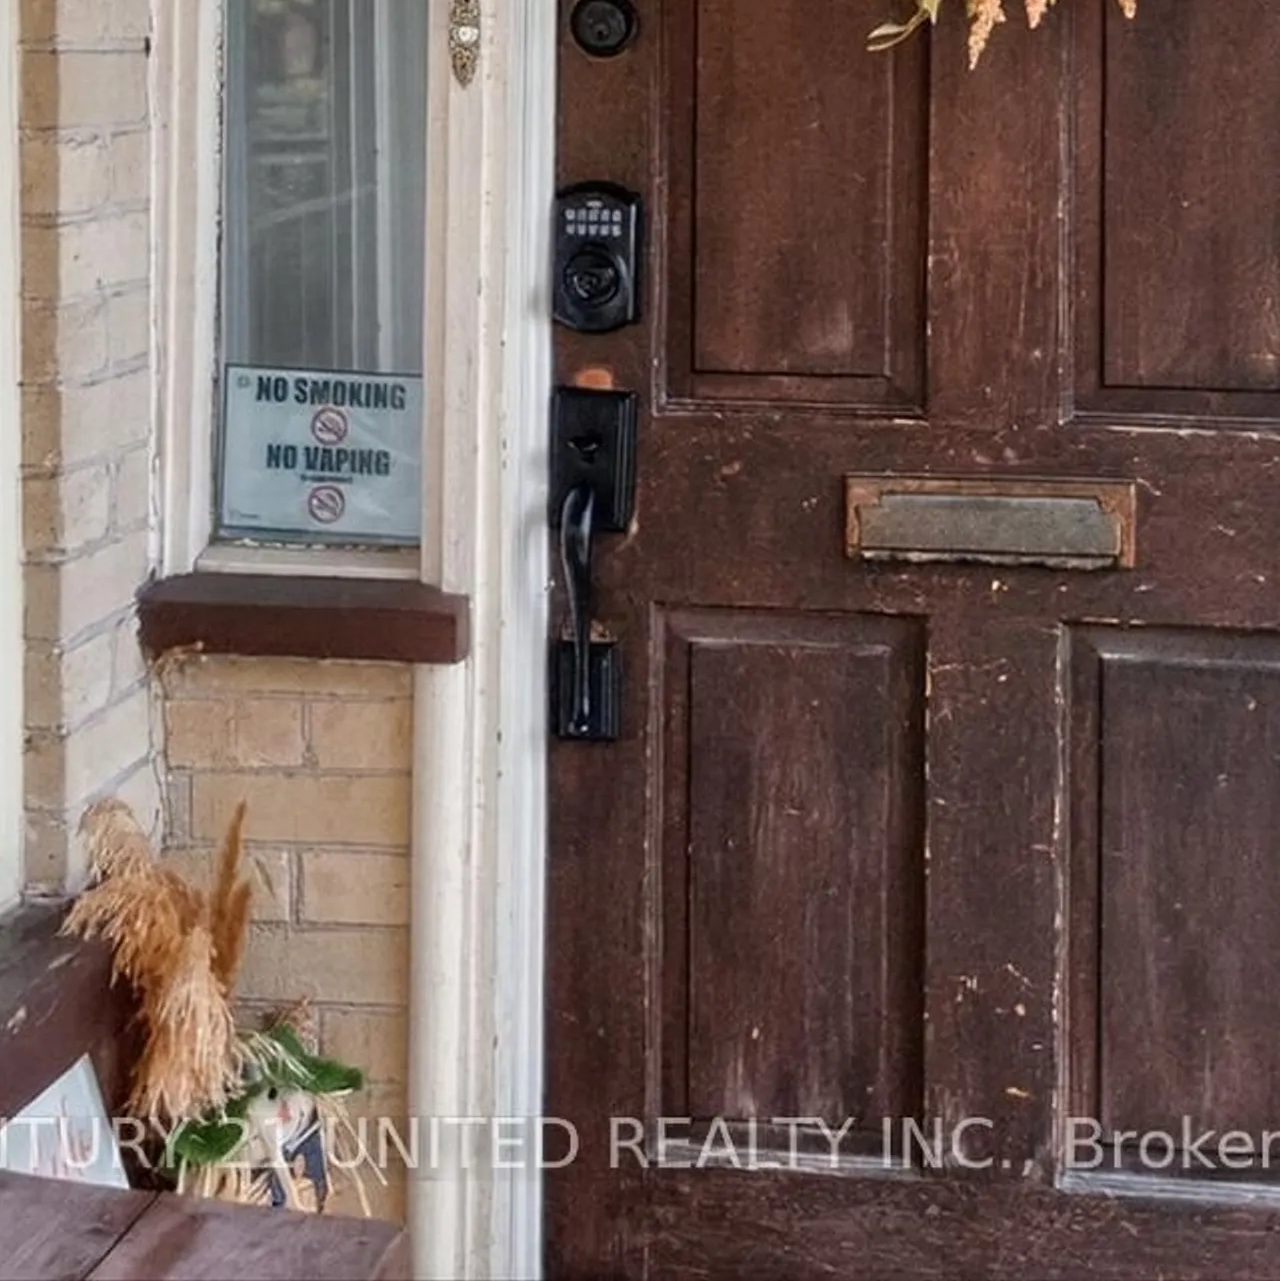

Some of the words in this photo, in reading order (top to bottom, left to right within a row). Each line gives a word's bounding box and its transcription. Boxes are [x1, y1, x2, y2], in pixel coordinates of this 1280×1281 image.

[256, 376, 288, 402] NO
[294, 378, 406, 410] SMOKING
[266, 444, 297, 469] NO
[304, 446, 390, 476] VAPING
